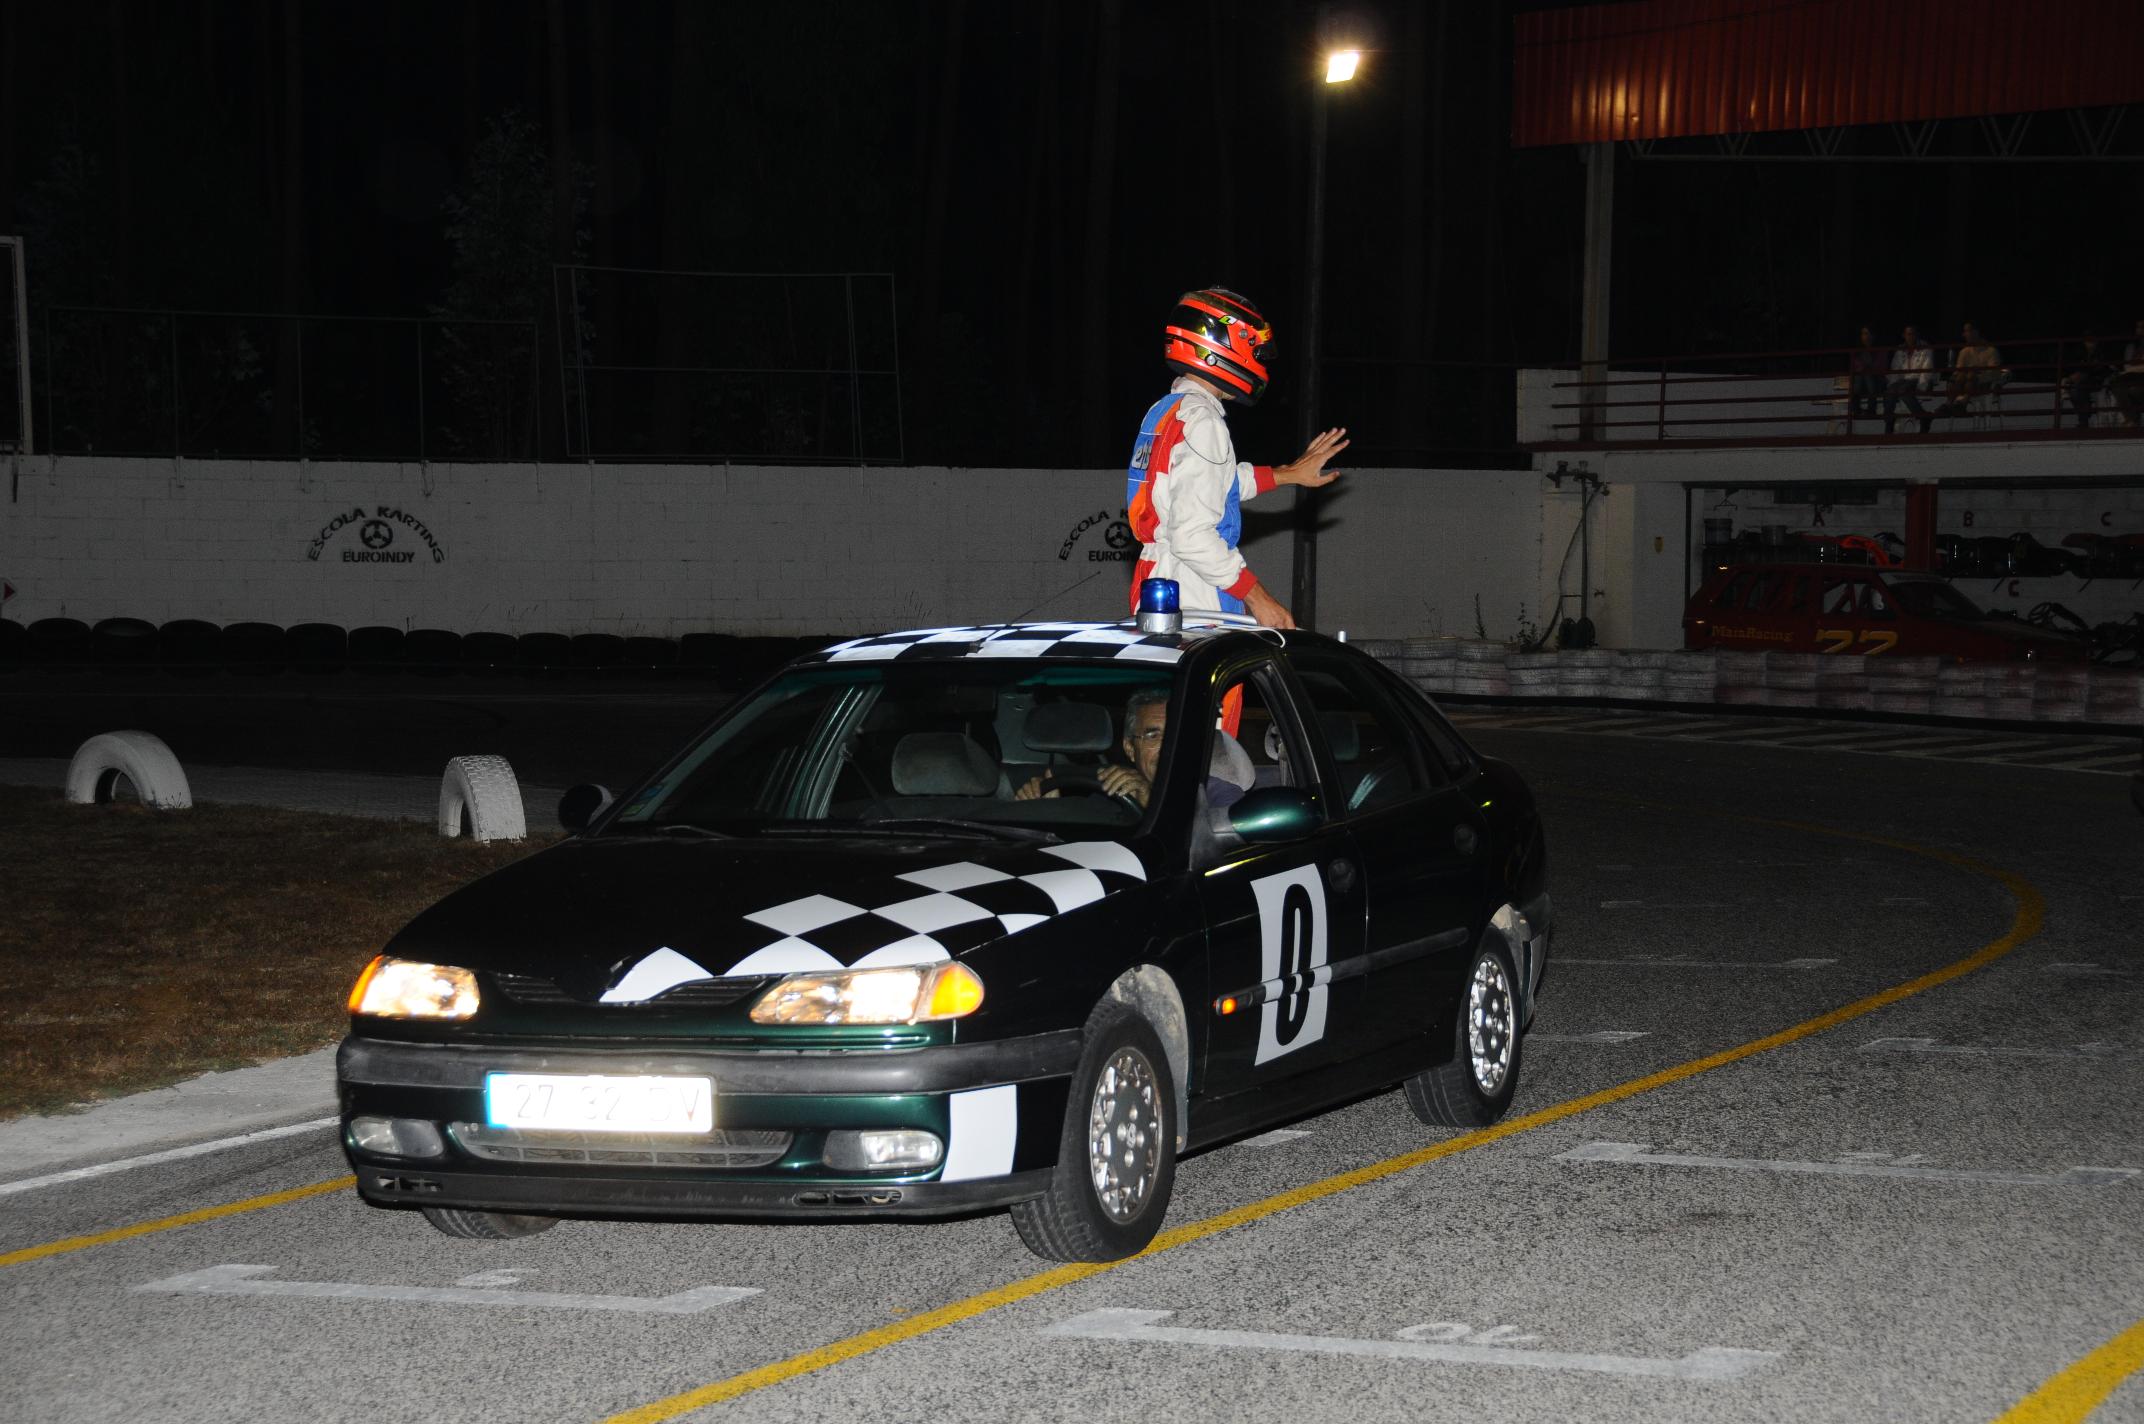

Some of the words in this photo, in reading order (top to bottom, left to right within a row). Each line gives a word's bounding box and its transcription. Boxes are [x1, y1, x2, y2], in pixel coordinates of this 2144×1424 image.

[308, 507, 366, 561] ESCOLA
[377, 506, 445, 563] KARTING
[342, 551, 415, 563] EUROINDY
[1058, 510, 1111, 561] ESCOLA
[1088, 550, 1136, 562] EUROIN
[1275, 883, 1316, 1047] 0
